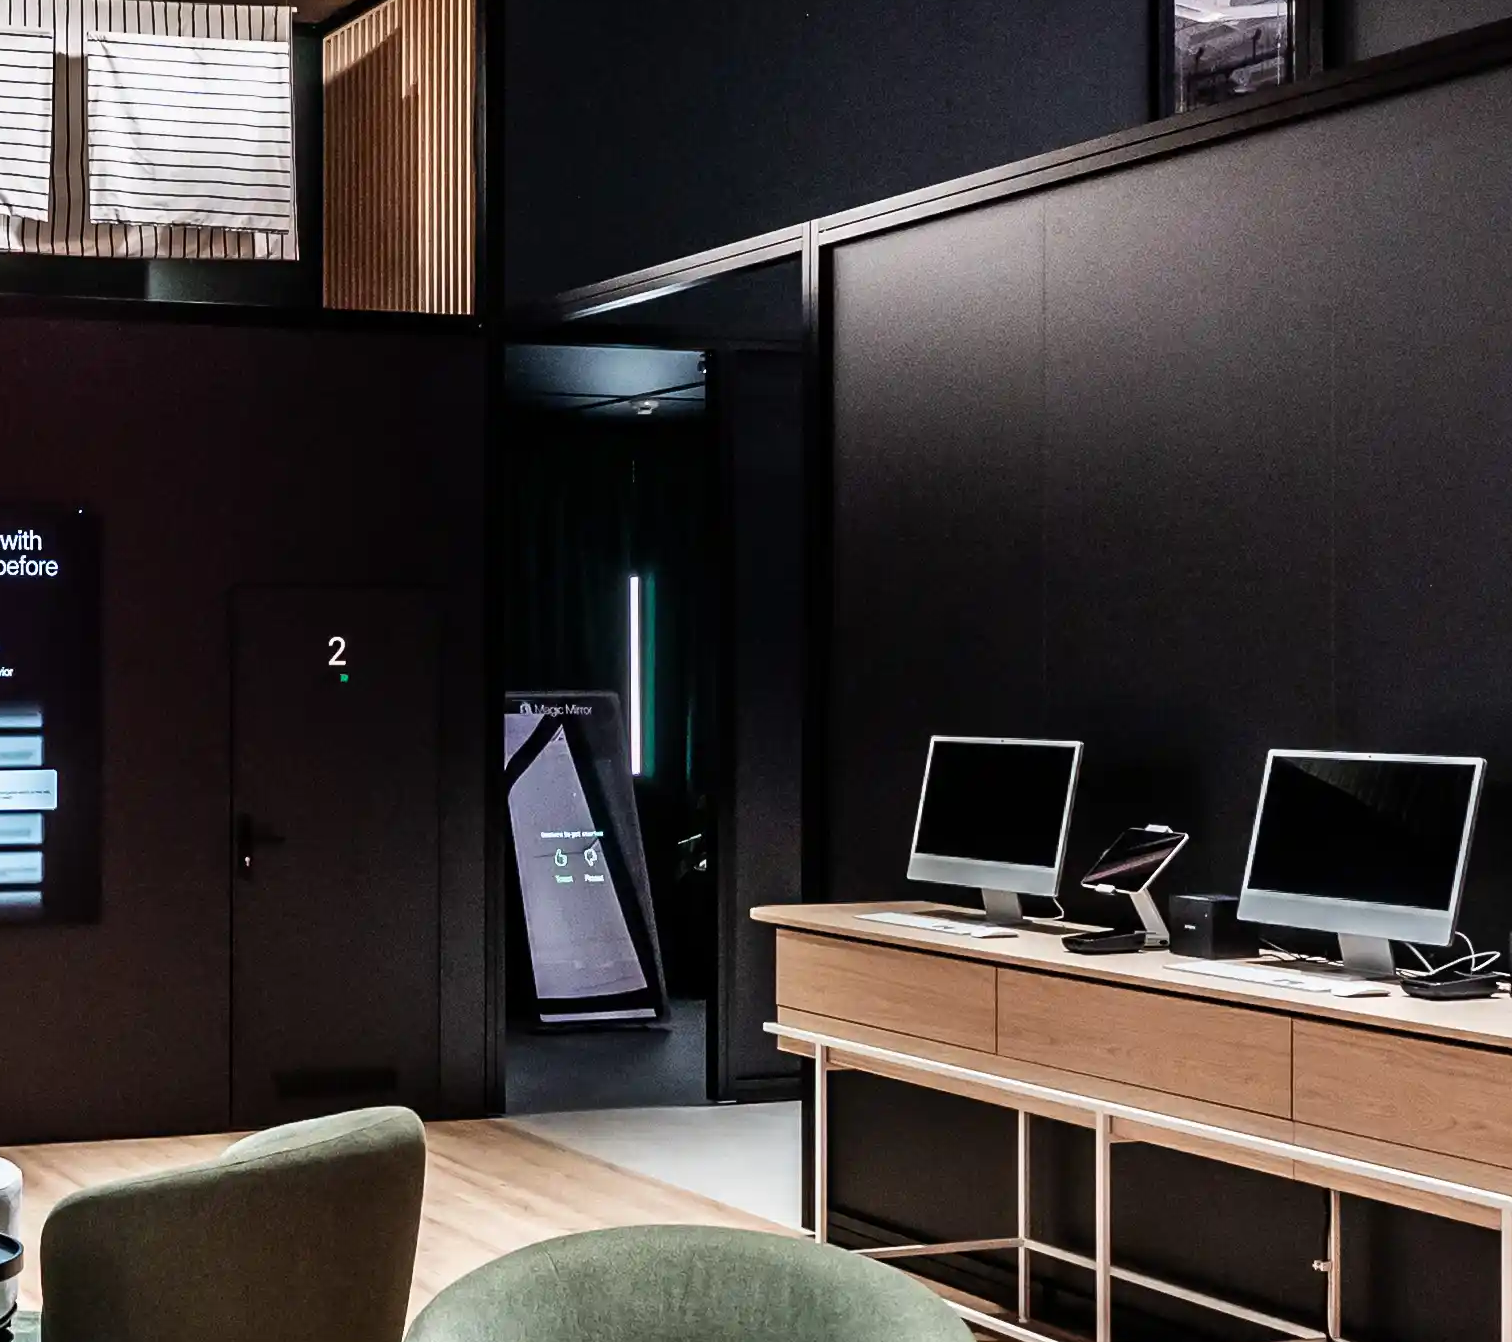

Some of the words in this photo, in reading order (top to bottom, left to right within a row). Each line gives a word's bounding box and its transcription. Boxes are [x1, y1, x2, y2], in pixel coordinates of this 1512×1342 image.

[0, 529, 42, 551] with
[328, 636, 346, 666] 2
[535, 704, 564, 717] Magic
[565, 704, 592, 715] Mirror
